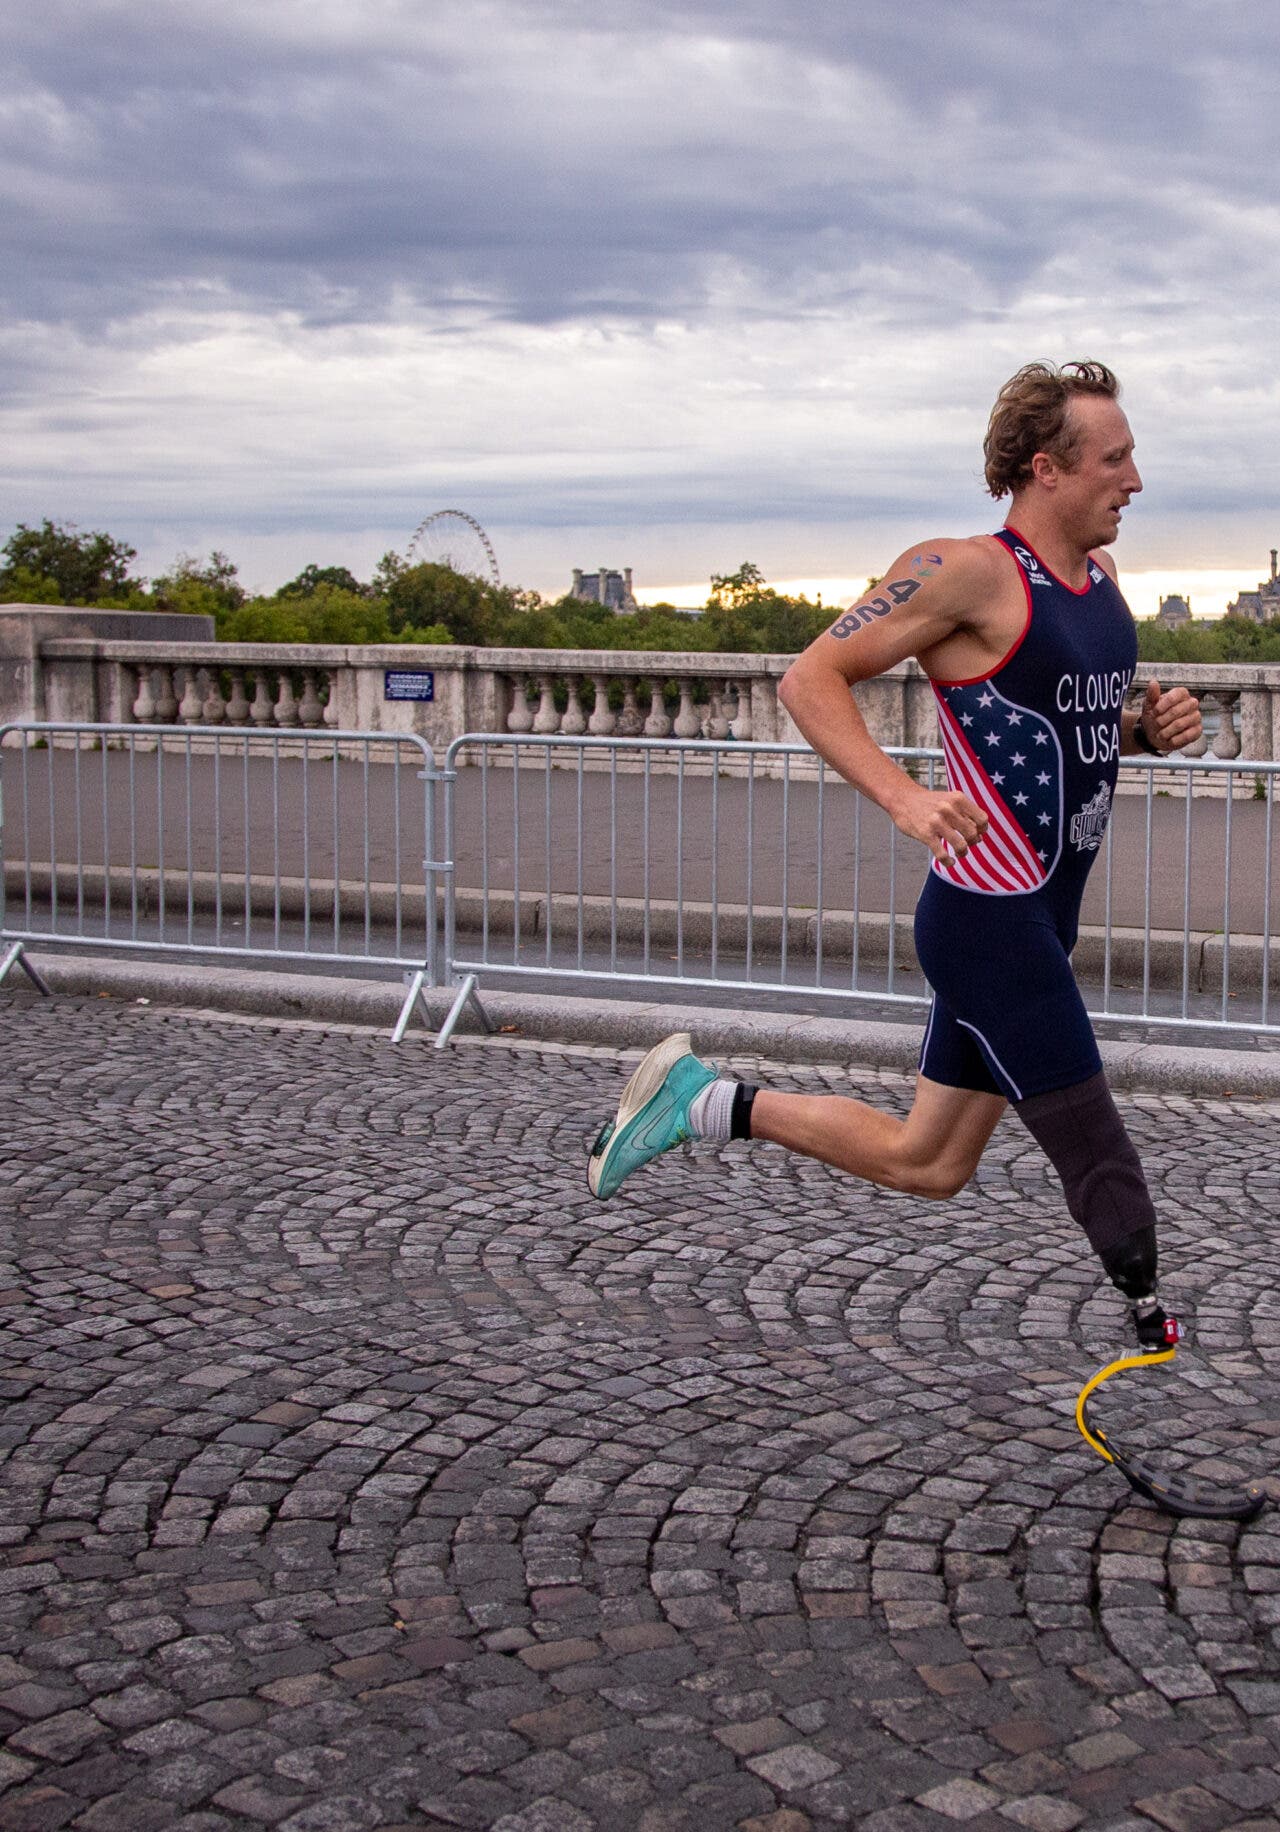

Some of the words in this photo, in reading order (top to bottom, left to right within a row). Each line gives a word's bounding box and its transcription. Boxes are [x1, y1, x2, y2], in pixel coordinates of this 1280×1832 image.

[828, 577, 924, 641] 428
[1056, 668, 1131, 712] CLOUGH
[1075, 723, 1120, 764] USA
